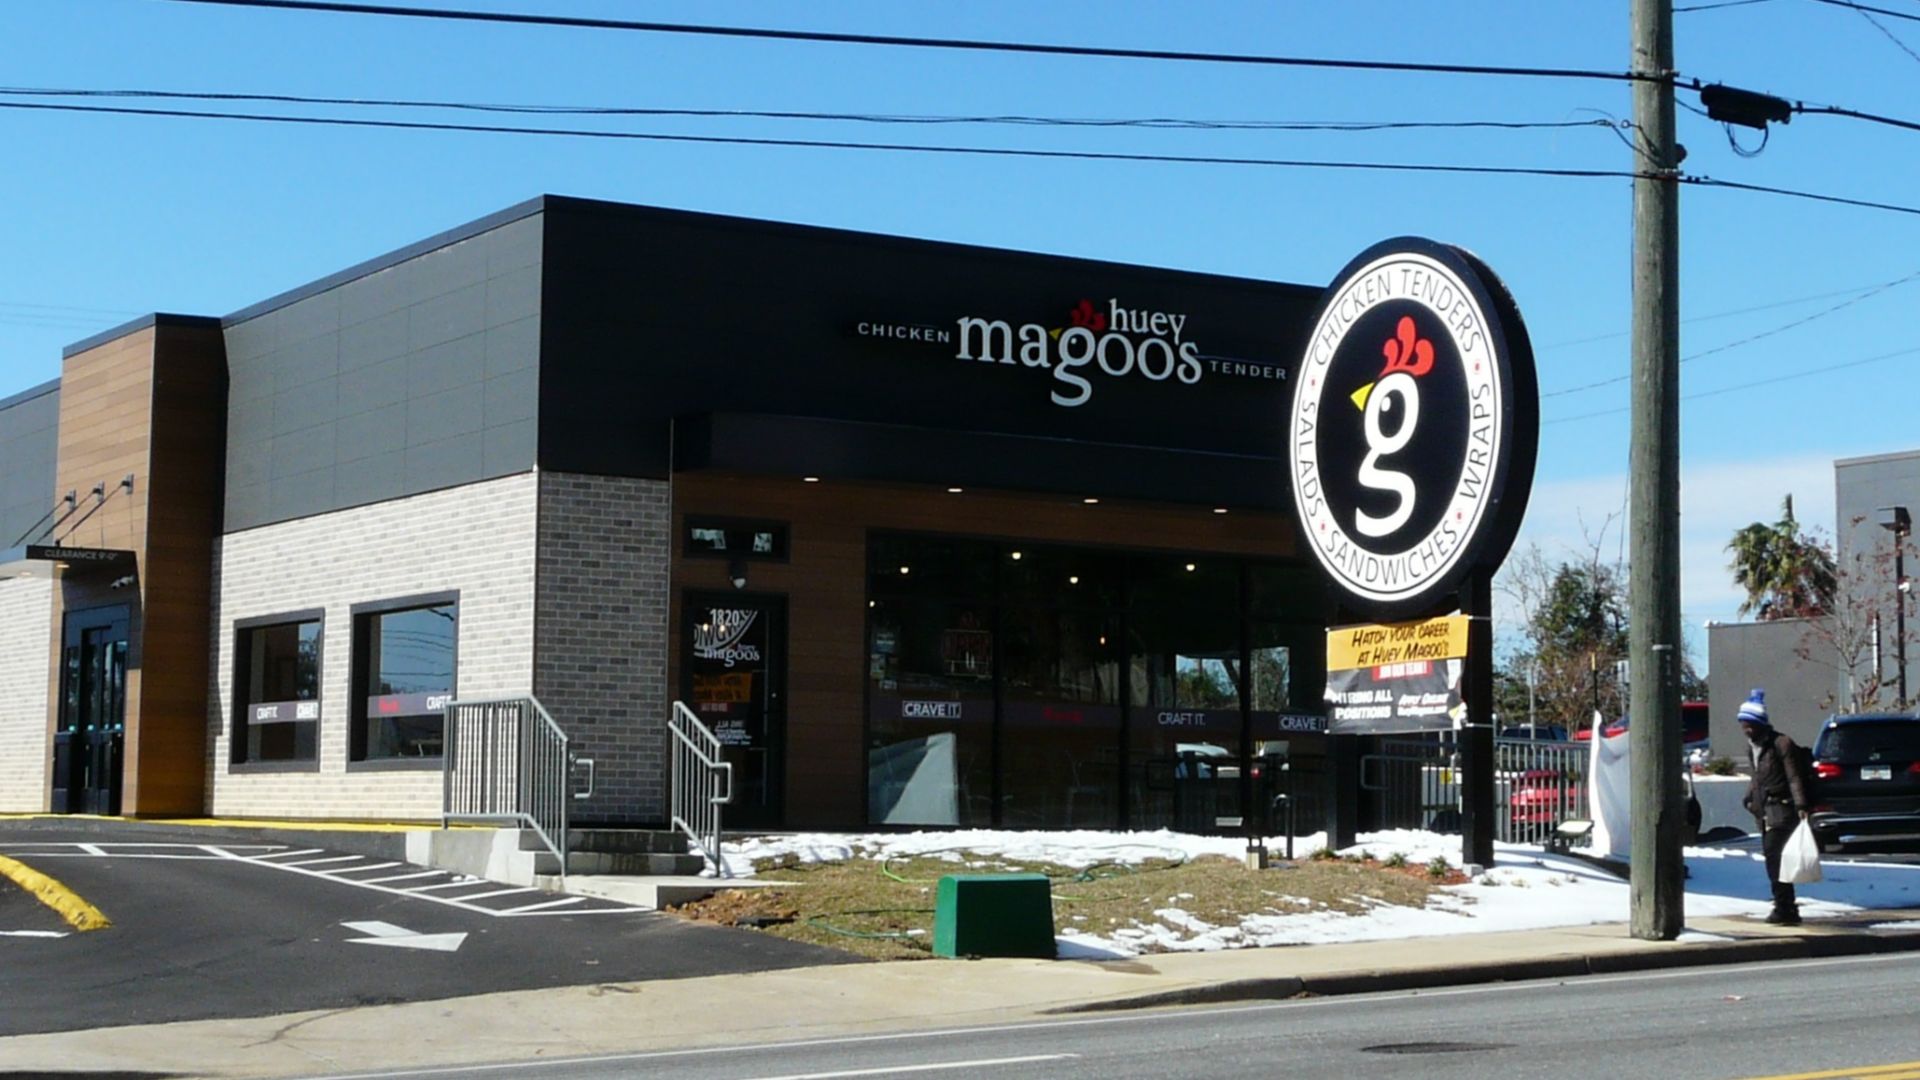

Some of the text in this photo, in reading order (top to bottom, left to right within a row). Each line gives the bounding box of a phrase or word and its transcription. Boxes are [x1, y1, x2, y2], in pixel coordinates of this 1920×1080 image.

[1108, 297, 1186, 346] huey
[1313, 268, 1481, 365] CHICKEN TENDERS
[858, 322, 950, 343] CHICKEN
[1459, 383, 1490, 500] WRAPS
[1298, 400, 1325, 518] SALADS
[1326, 520, 1458, 586] SANDWICHES
[709, 608, 740, 626] 1820
[1352, 622, 1450, 647] HATCH YOUR CAREER
[1357, 650, 1371, 665] AT
[1372, 647, 1402, 663] HUEY
[1375, 689, 1394, 703] ALL
[904, 702, 945, 717] CRAVE
[1158, 712, 1192, 726] CRAFT
[1335, 706, 1391, 720] POSITIONS
[1280, 717, 1316, 730] CRAVE
